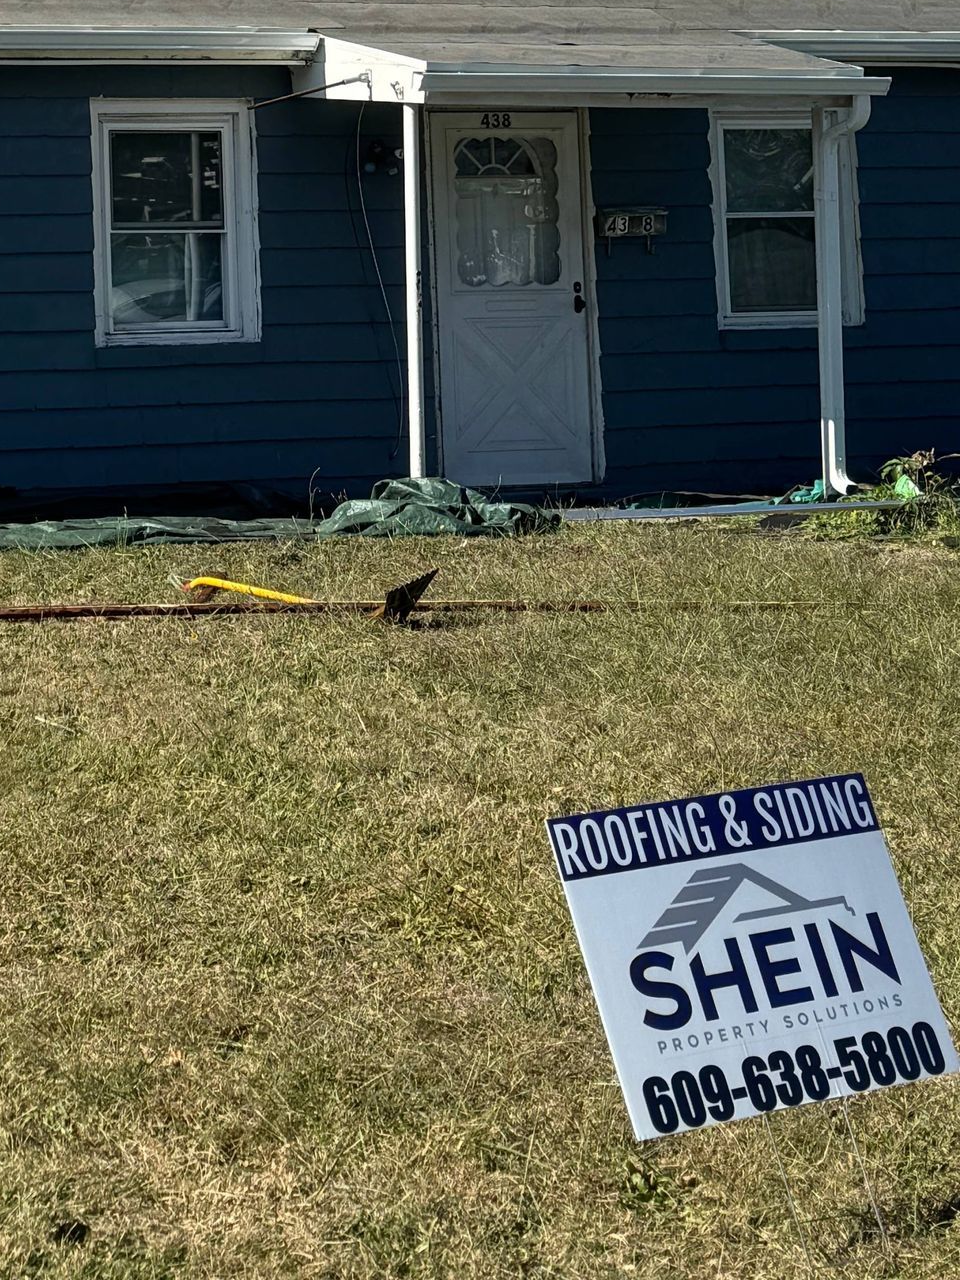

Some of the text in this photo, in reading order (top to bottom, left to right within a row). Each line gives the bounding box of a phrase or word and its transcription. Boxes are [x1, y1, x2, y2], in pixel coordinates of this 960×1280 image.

[481, 113, 511, 128] 438
[607, 217, 653, 233] 43 8
[553, 778, 874, 875] ROOFING & SIDING
[629, 912, 902, 1031] SHEIN
[657, 994, 903, 1055] PROPERTY SOLUTIONS
[643, 1021, 946, 1134] 609-638-5800
